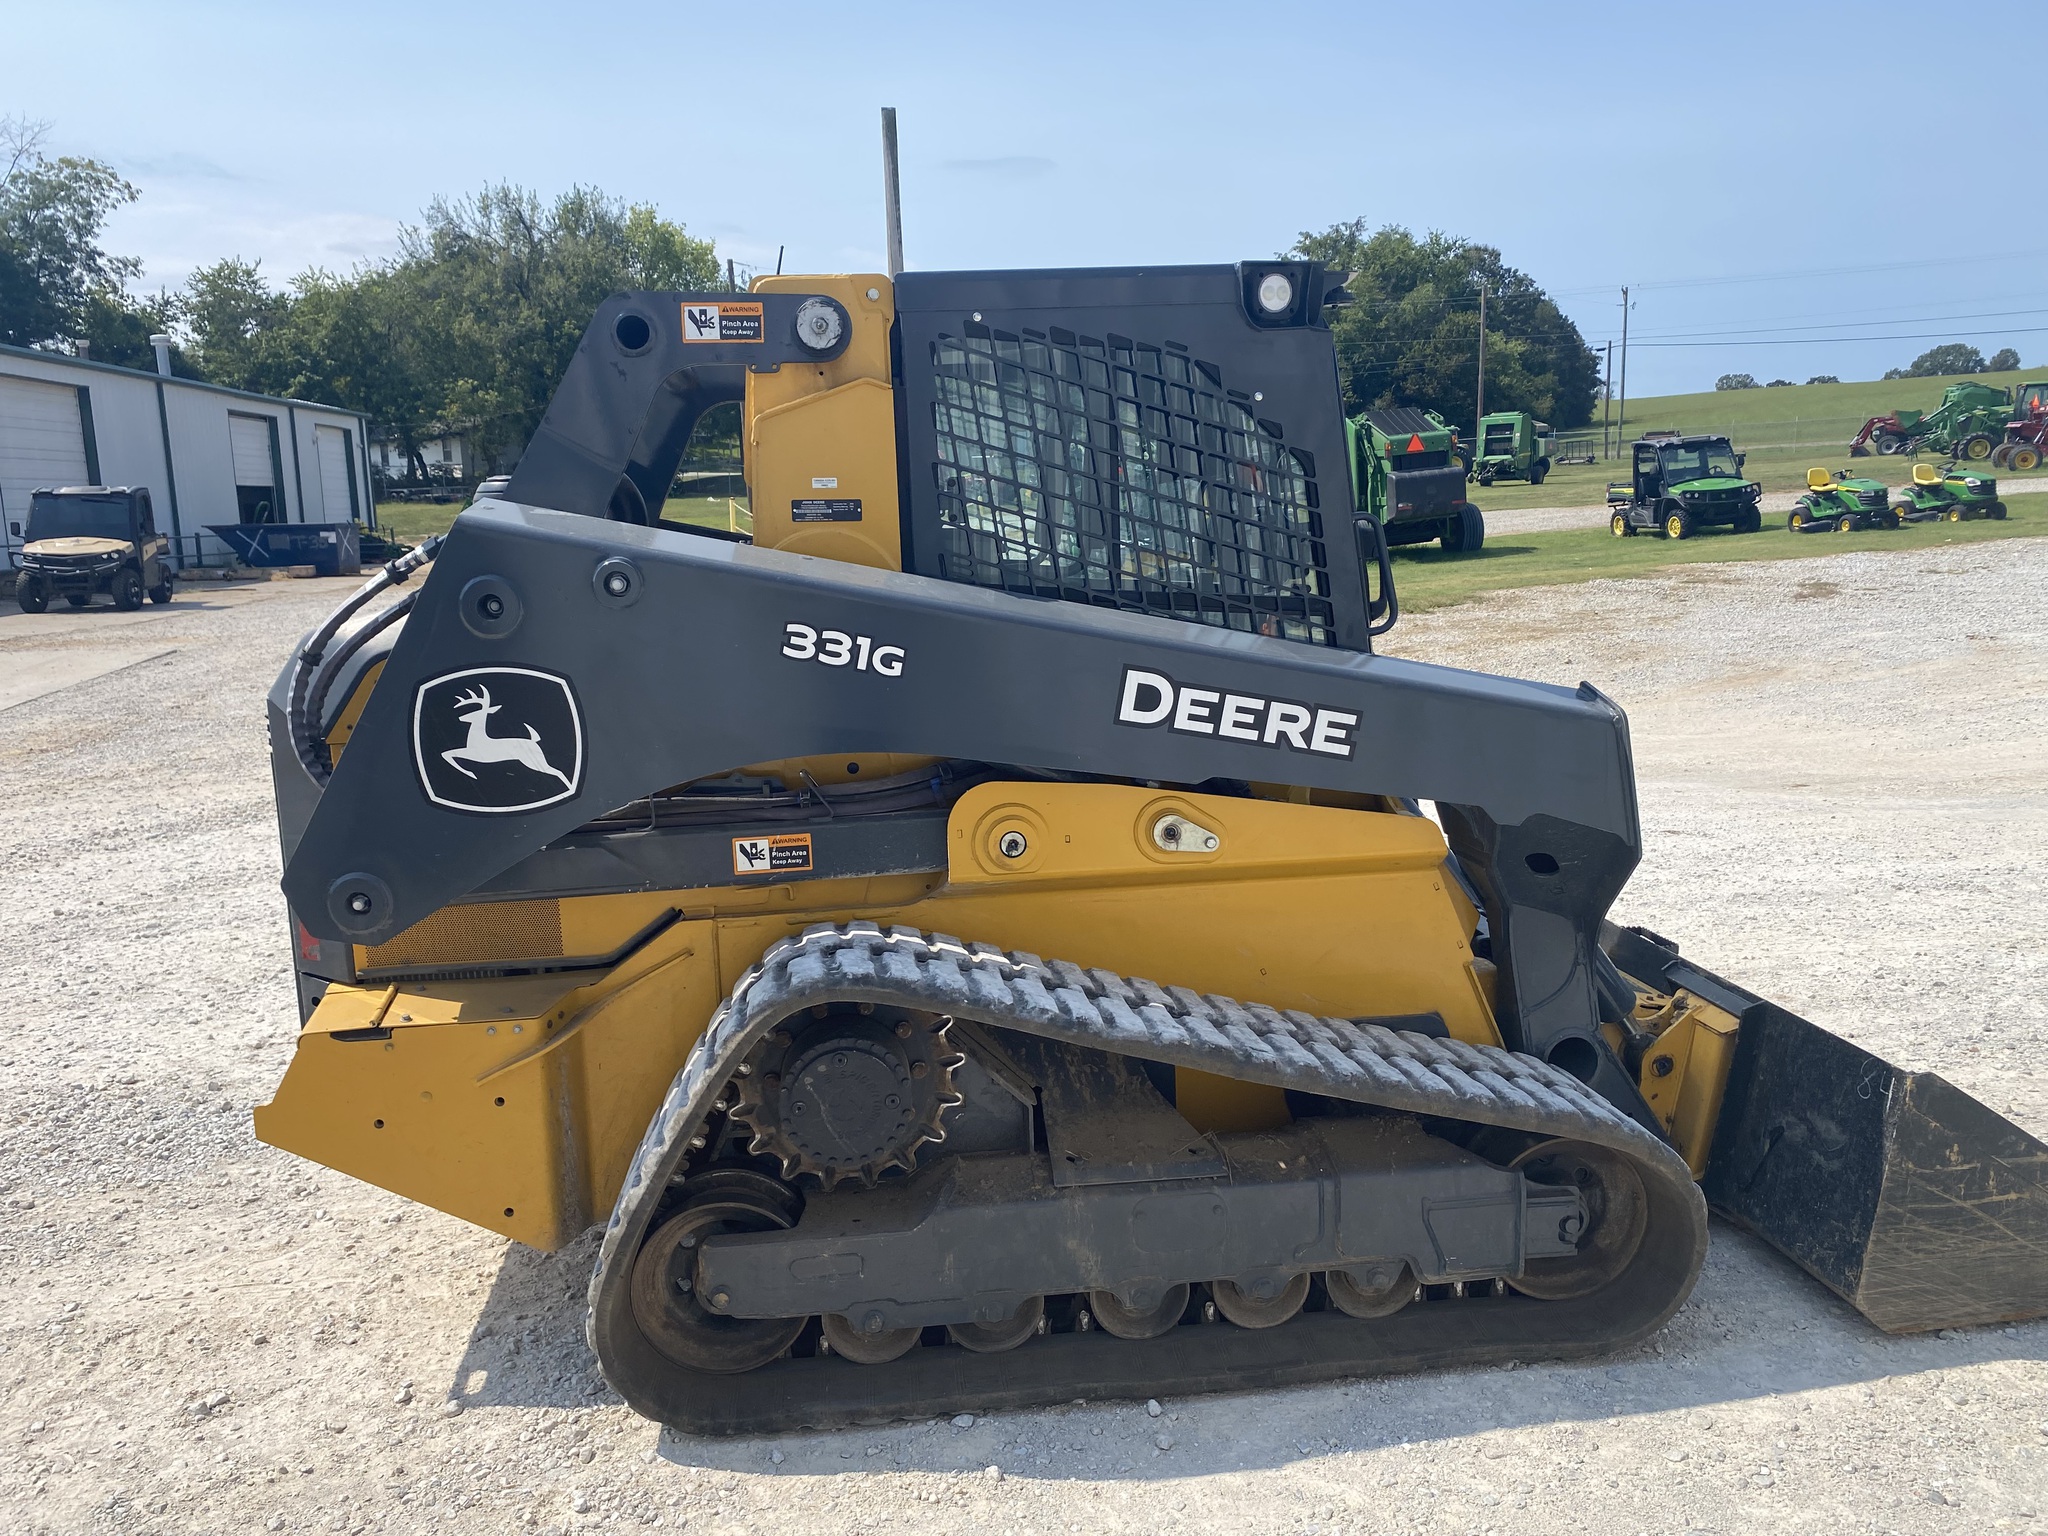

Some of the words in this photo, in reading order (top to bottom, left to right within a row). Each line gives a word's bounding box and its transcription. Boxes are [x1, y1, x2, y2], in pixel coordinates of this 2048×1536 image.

[782, 623, 905, 677] 331G
[1119, 669, 1358, 756] DEERE
[772, 850, 791, 858] Pinch
[778, 836, 808, 845] WARNING
